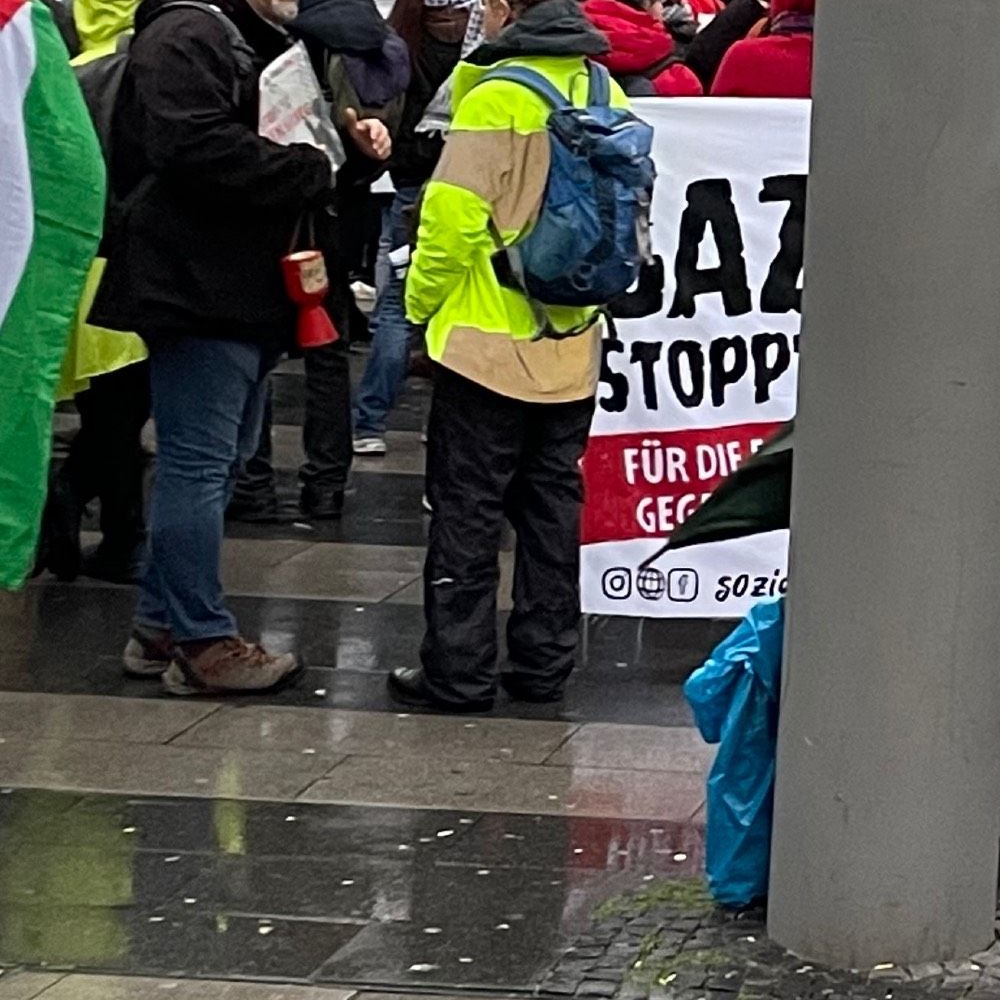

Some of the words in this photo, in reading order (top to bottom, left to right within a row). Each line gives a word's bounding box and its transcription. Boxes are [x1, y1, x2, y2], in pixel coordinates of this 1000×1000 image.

[599, 333, 800, 413] STOPP
[623, 439, 690, 485] FÜR
[636, 492, 713, 534] GEG
